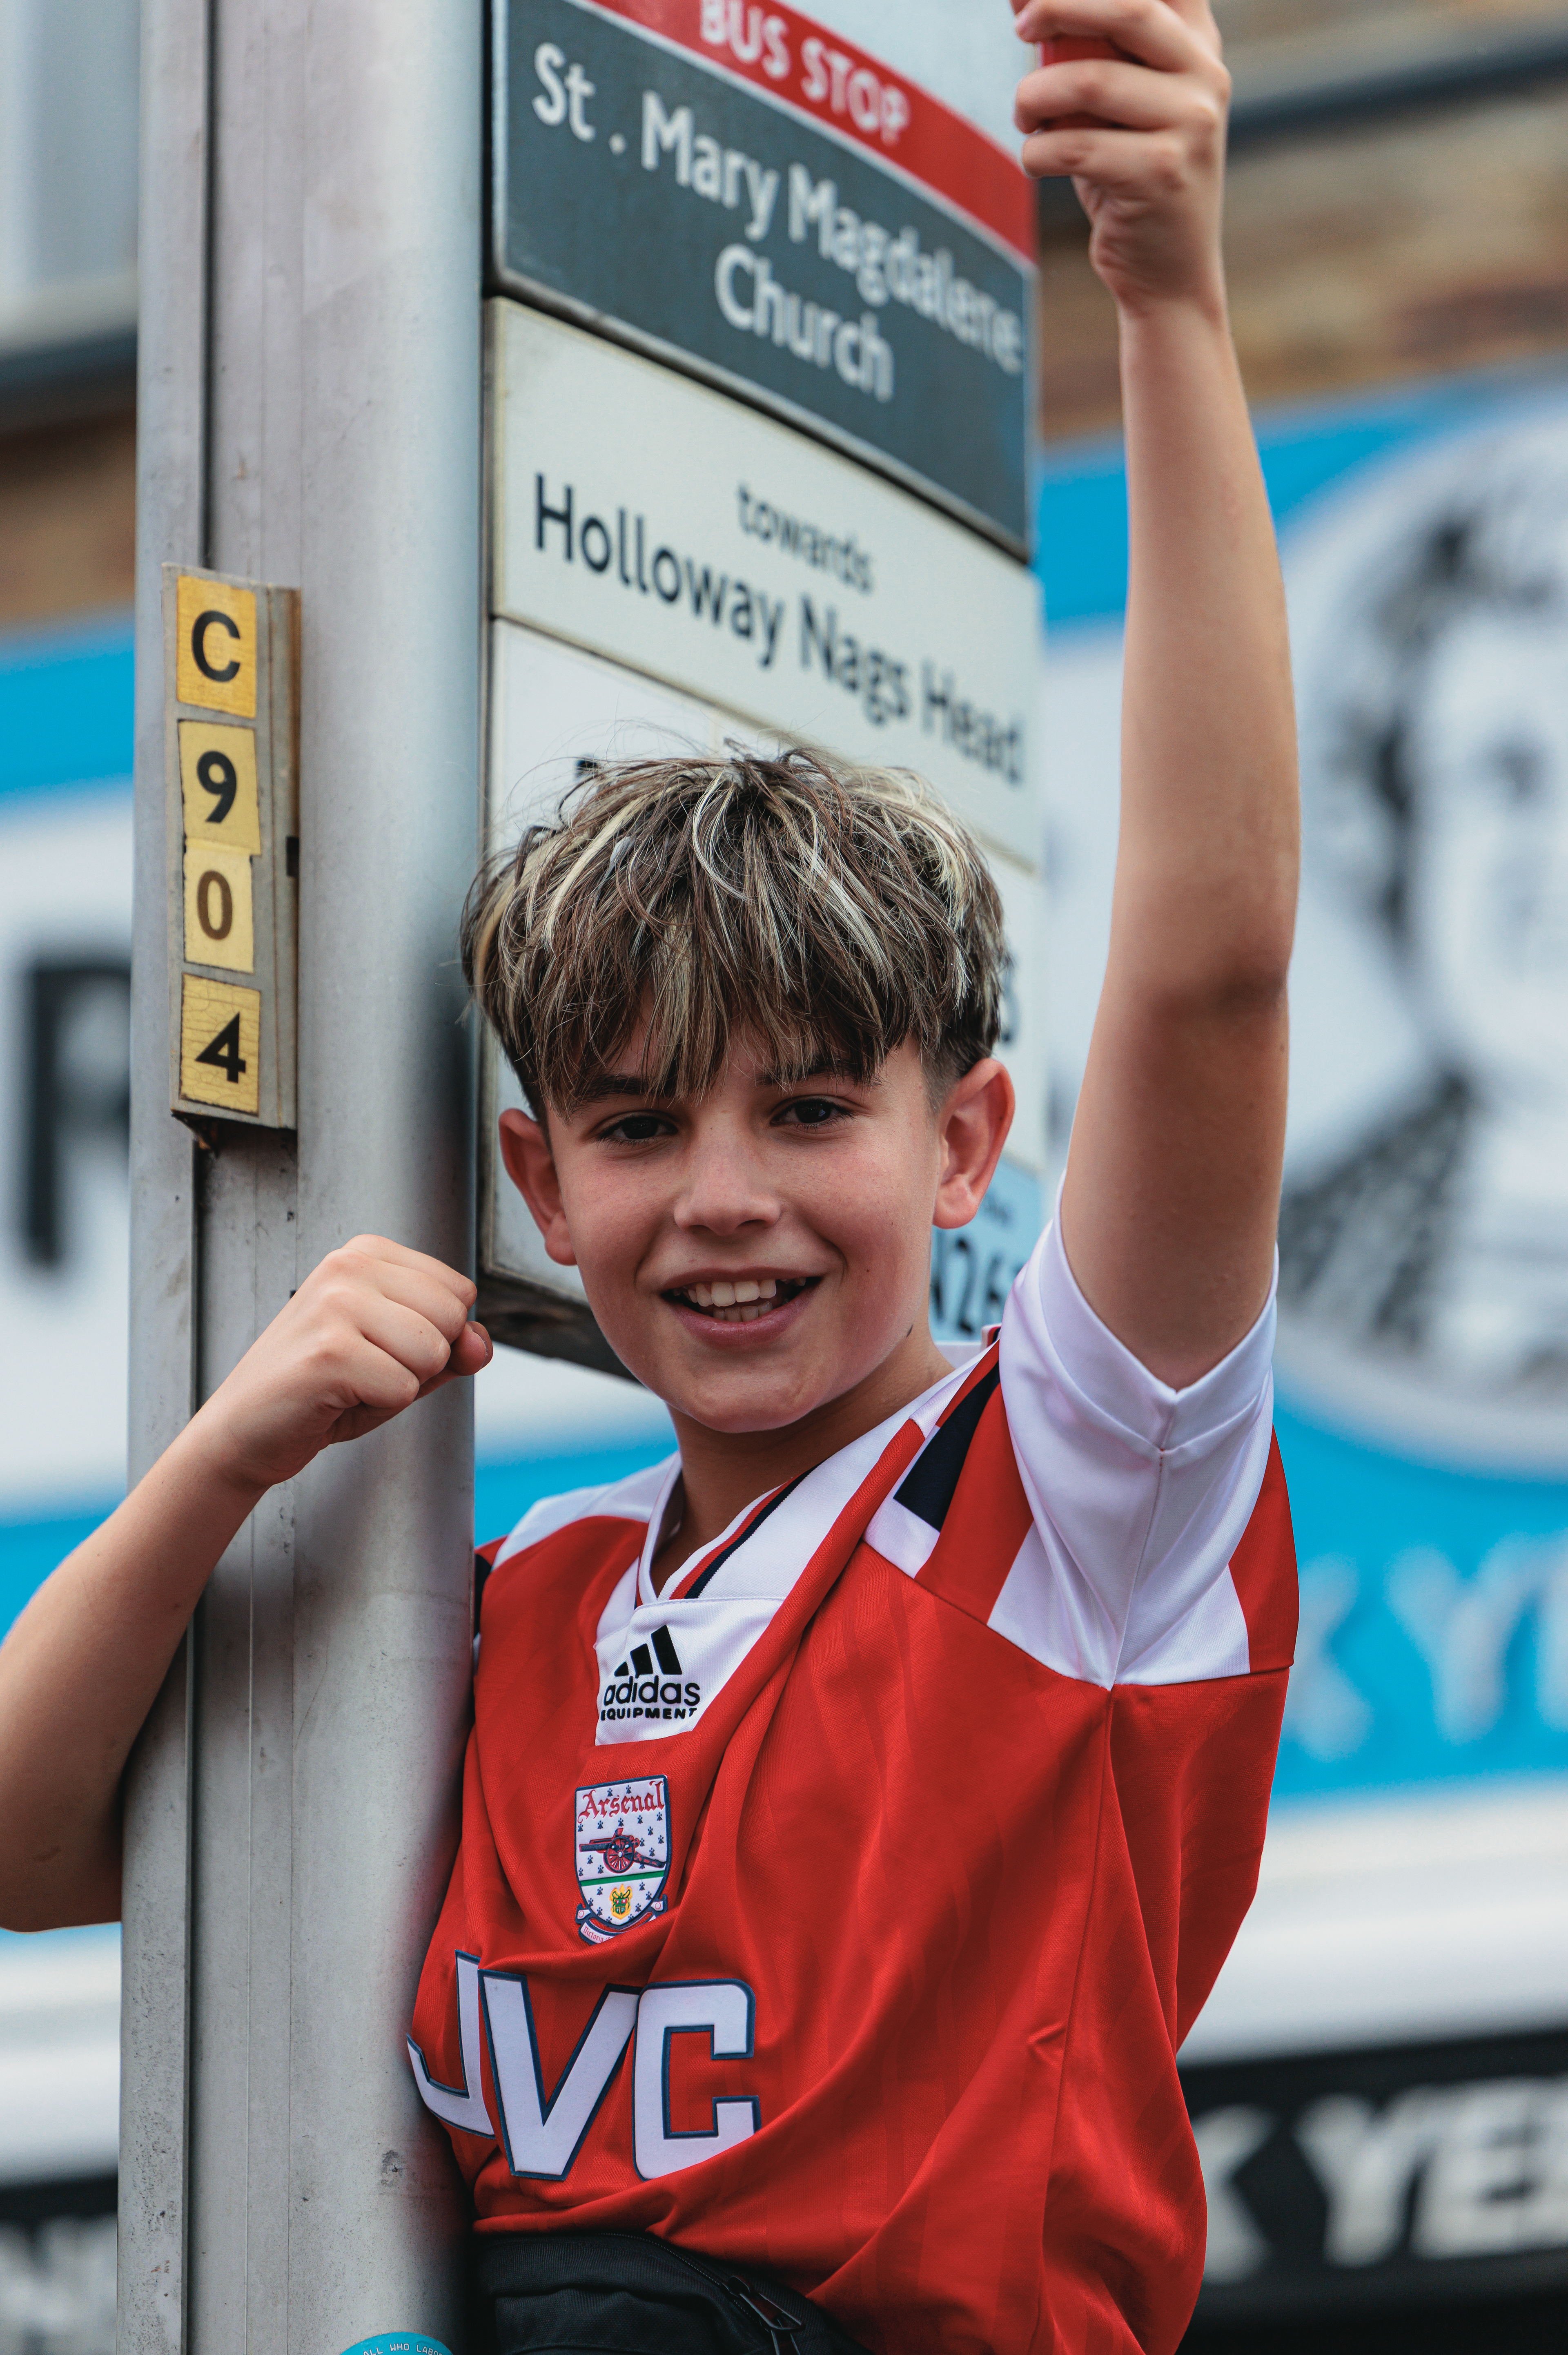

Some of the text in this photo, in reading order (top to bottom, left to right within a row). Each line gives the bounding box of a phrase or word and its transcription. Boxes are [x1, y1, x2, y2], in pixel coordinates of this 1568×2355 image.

[701, 0, 910, 146] BUS STOP
[640, 89, 779, 242] Mary
[787, 163, 1024, 376] Magdalene
[714, 244, 895, 404] Church
[735, 481, 876, 595] towards
[533, 472, 1024, 786] Holloway Nags Head
[600, 1707, 697, 1721] EQUIPMENT
[604, 1675, 700, 1706] adidas
[577, 1780, 665, 1824] Arsenal
[406, 1948, 764, 2182] JVC
[389, 2343, 410, 2352] WHO
[416, 2344, 443, 2355] LABO
